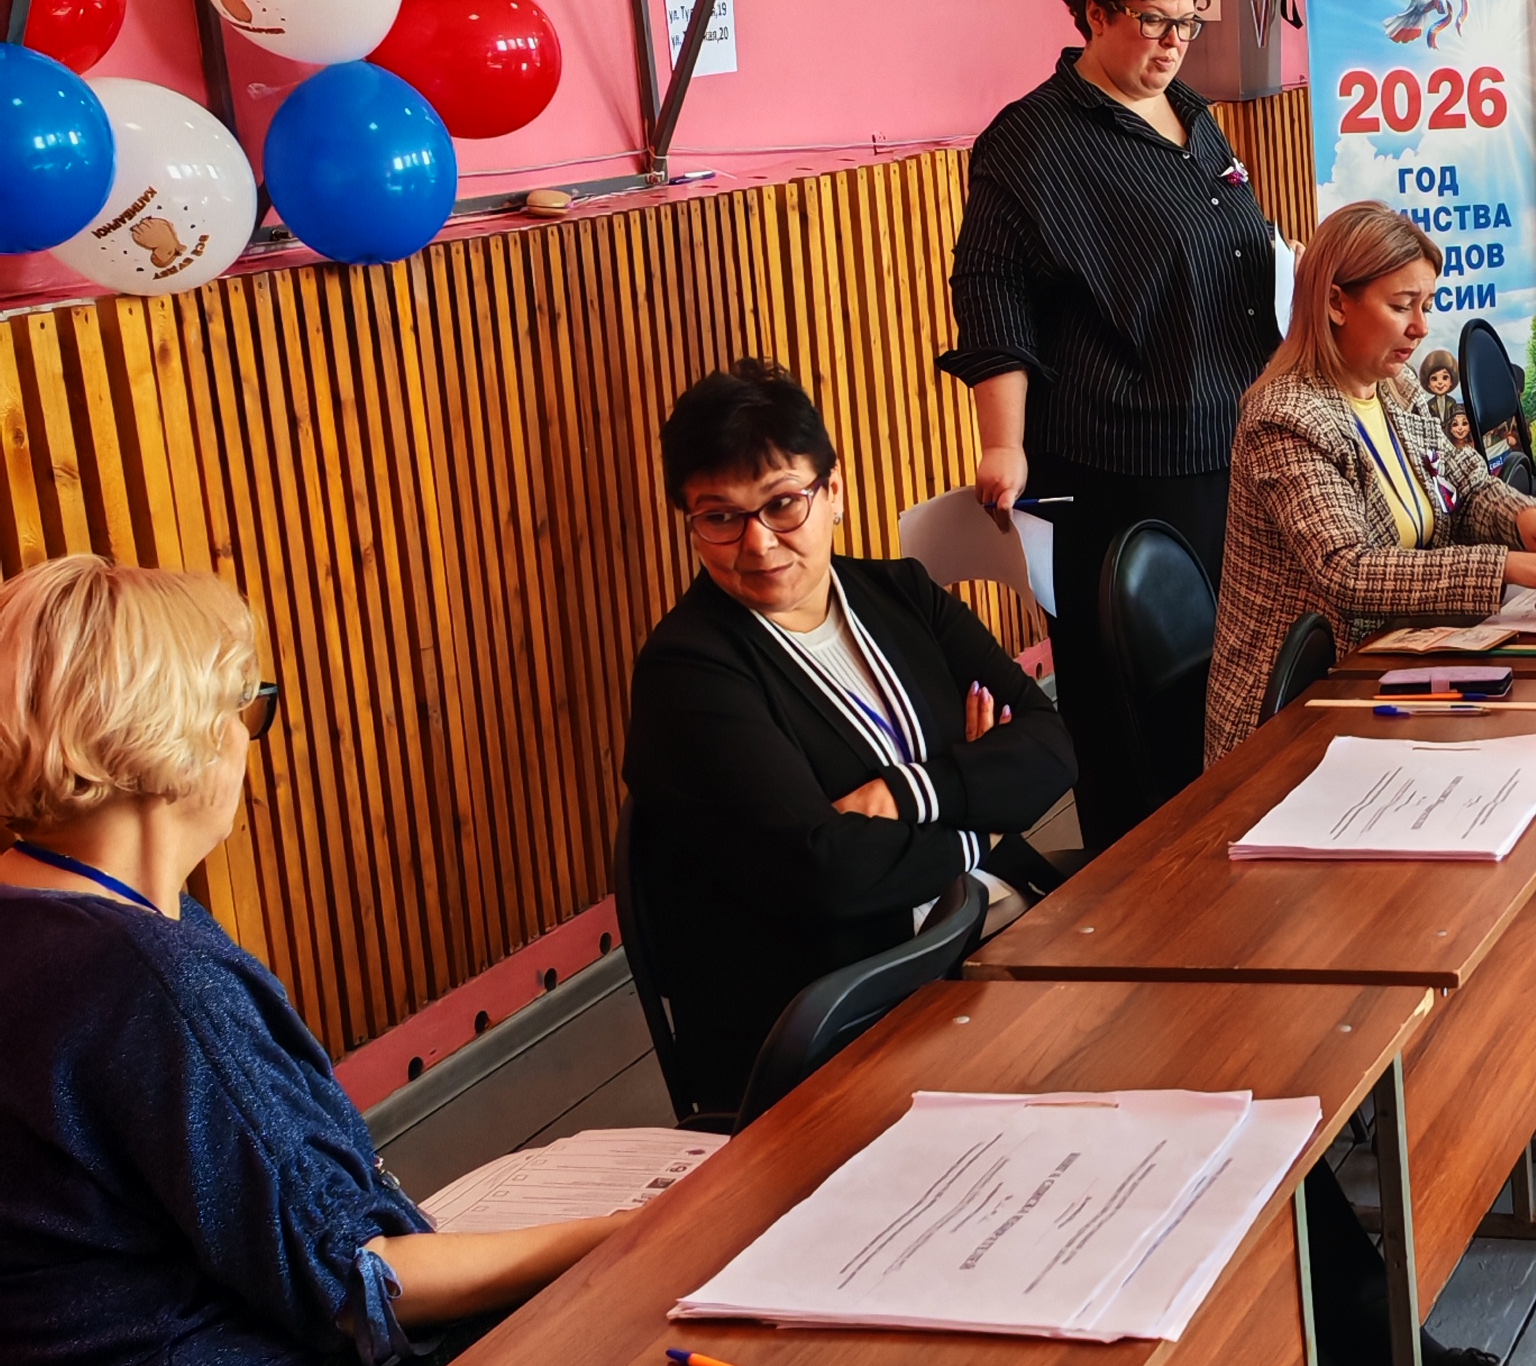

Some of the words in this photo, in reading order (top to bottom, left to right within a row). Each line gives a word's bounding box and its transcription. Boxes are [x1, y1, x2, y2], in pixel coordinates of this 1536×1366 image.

[1338, 66, 1508, 134] 2026
[1398, 165, 1460, 197] ГОД
[1400, 202, 1512, 233] НСТВА
[1434, 282, 1497, 313] СИИ
